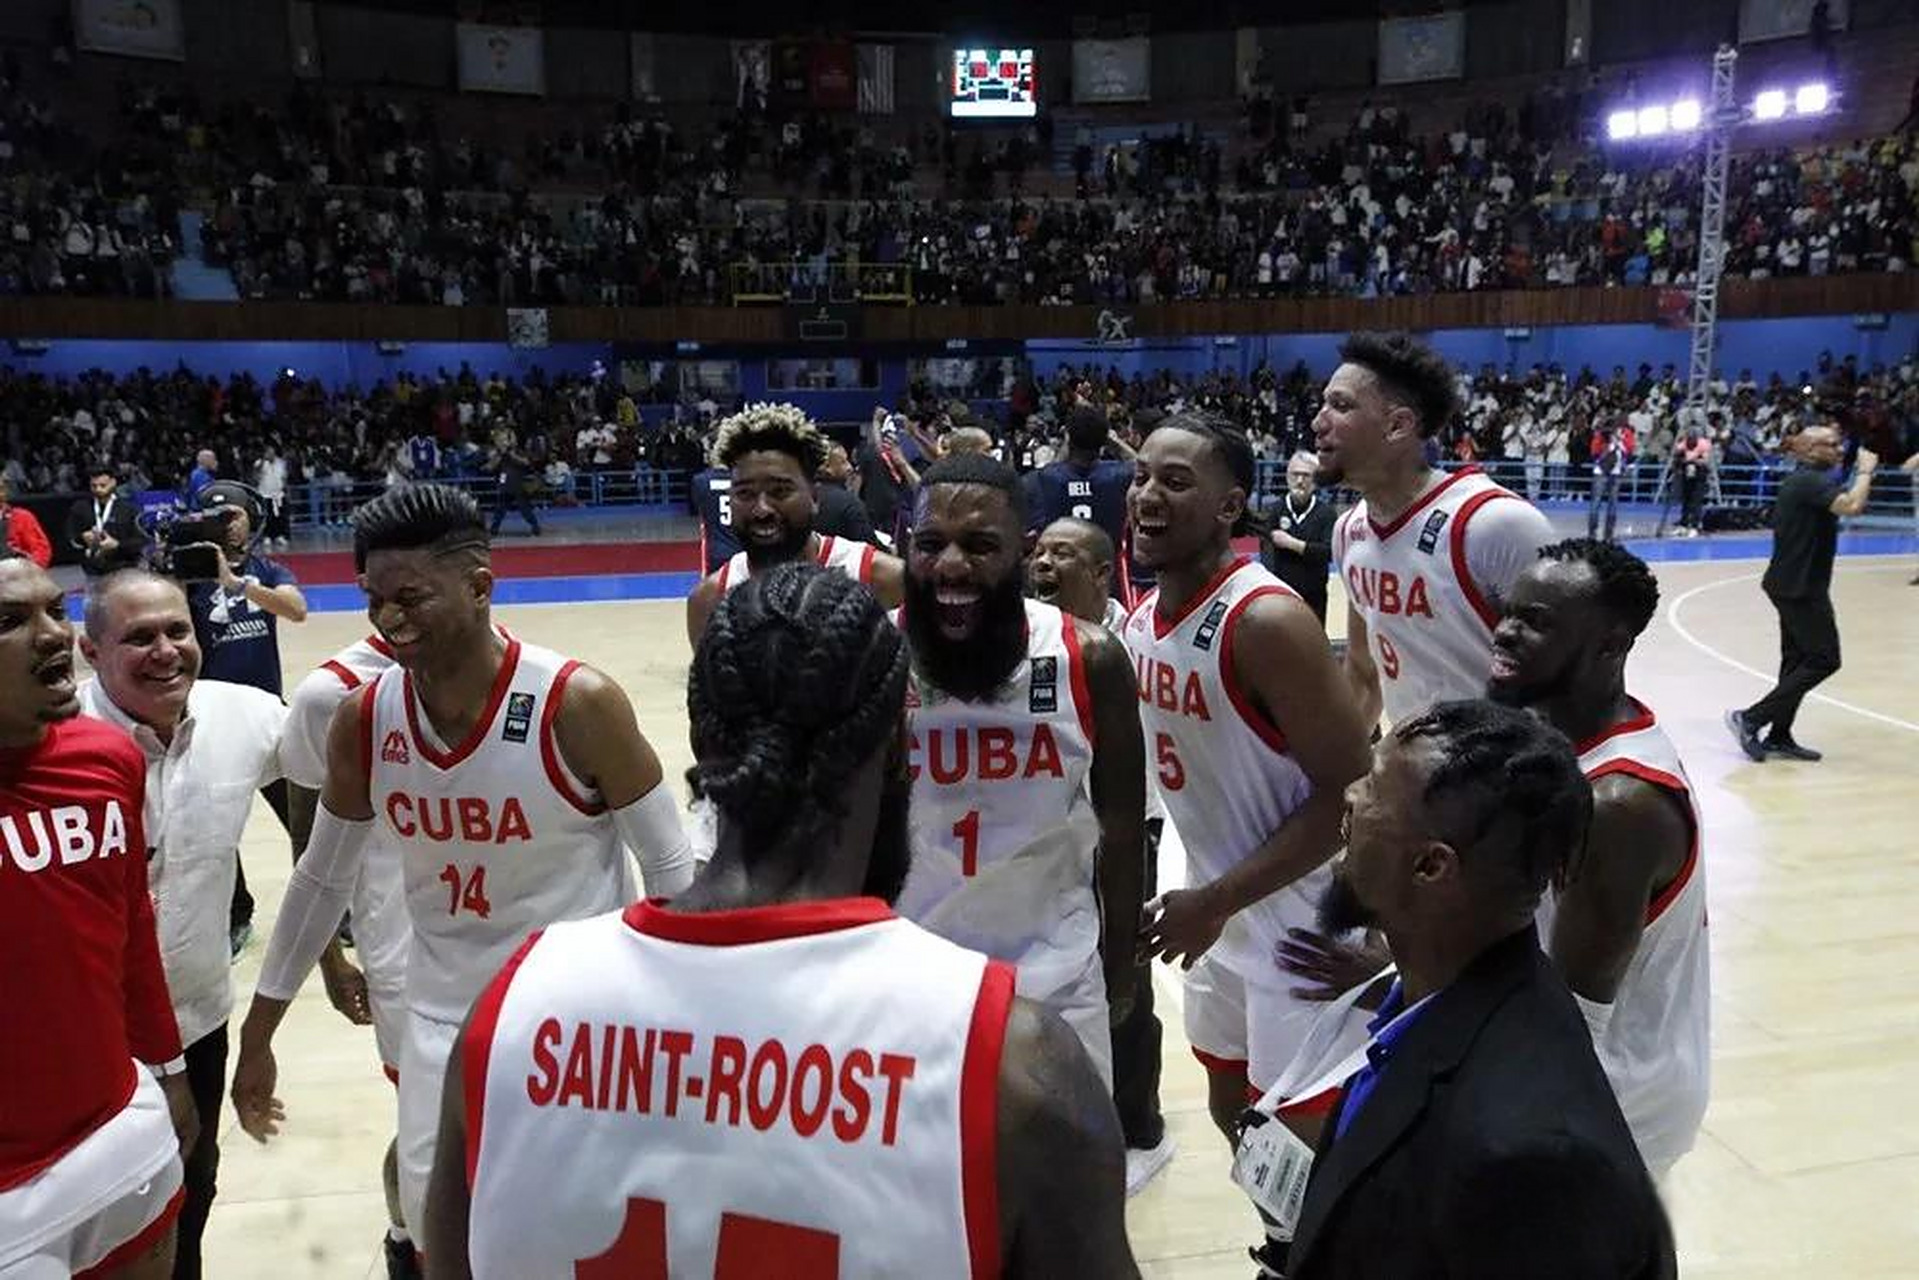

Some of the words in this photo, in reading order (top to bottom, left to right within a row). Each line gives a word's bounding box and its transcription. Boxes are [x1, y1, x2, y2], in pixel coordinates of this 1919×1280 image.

[1349, 565, 1434, 619] CUBA
[1376, 633, 1399, 680] 9
[1136, 654, 1212, 722] UBA
[1157, 733, 1185, 790] 5
[0, 800, 127, 873] UBA
[386, 791, 533, 844] CUBA
[953, 810, 979, 877] 1
[439, 864, 491, 919] 14
[527, 1016, 916, 1146] SAINT-ROOST
